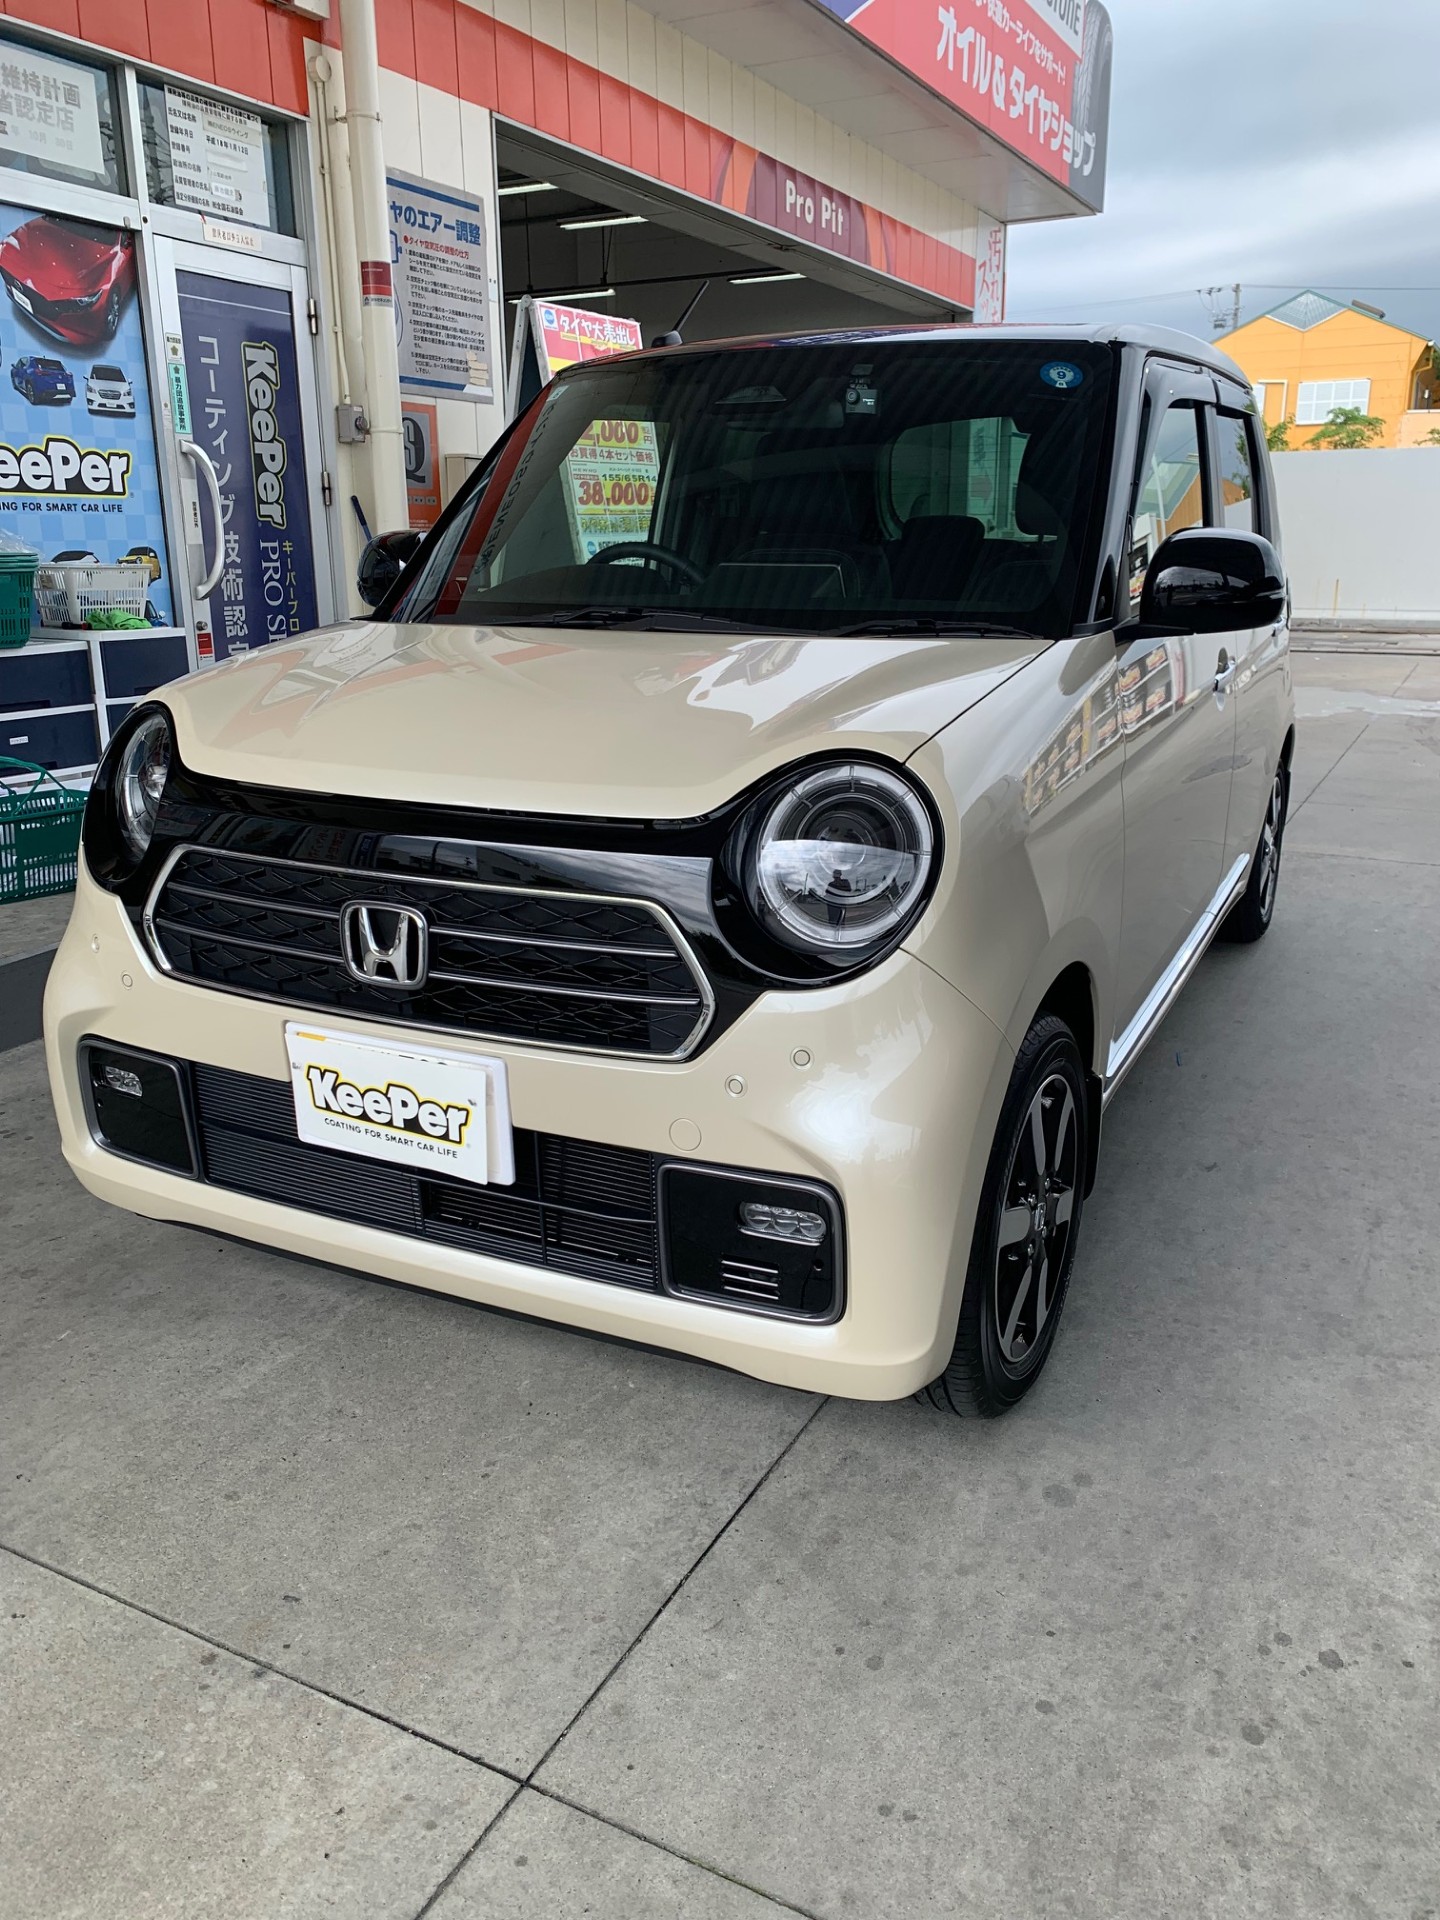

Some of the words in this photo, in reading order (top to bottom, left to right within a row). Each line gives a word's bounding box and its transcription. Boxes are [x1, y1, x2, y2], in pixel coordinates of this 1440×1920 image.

[936, 5, 1096, 176] オイル&タイヤショップ
[390, 200, 482, 247] ヤのエアー調整
[785, 179, 814, 225] Pro
[820, 196, 844, 236] Pit
[560, 314, 636, 345] タイヤ大売出し
[241, 341, 287, 530] KeePer
[578, 481, 649, 506] 38,000
[601, 473, 657, 482] 155/65R14
[22, 502, 42, 511] FOR
[46, 502, 77, 512] SMART
[81, 503, 99, 513] CAR
[102, 504, 123, 513] LIFE
[260, 539, 284, 607] PRO
[283, 540, 300, 632] キーパープロ
[306, 1063, 471, 1146] KeePer
[324, 1117, 361, 1134] COATING
[364, 1128, 382, 1140] FOR
[385, 1133, 414, 1148] SMART
[417, 1141, 435, 1153] CAR
[437, 1146, 458, 1159] LIFE
